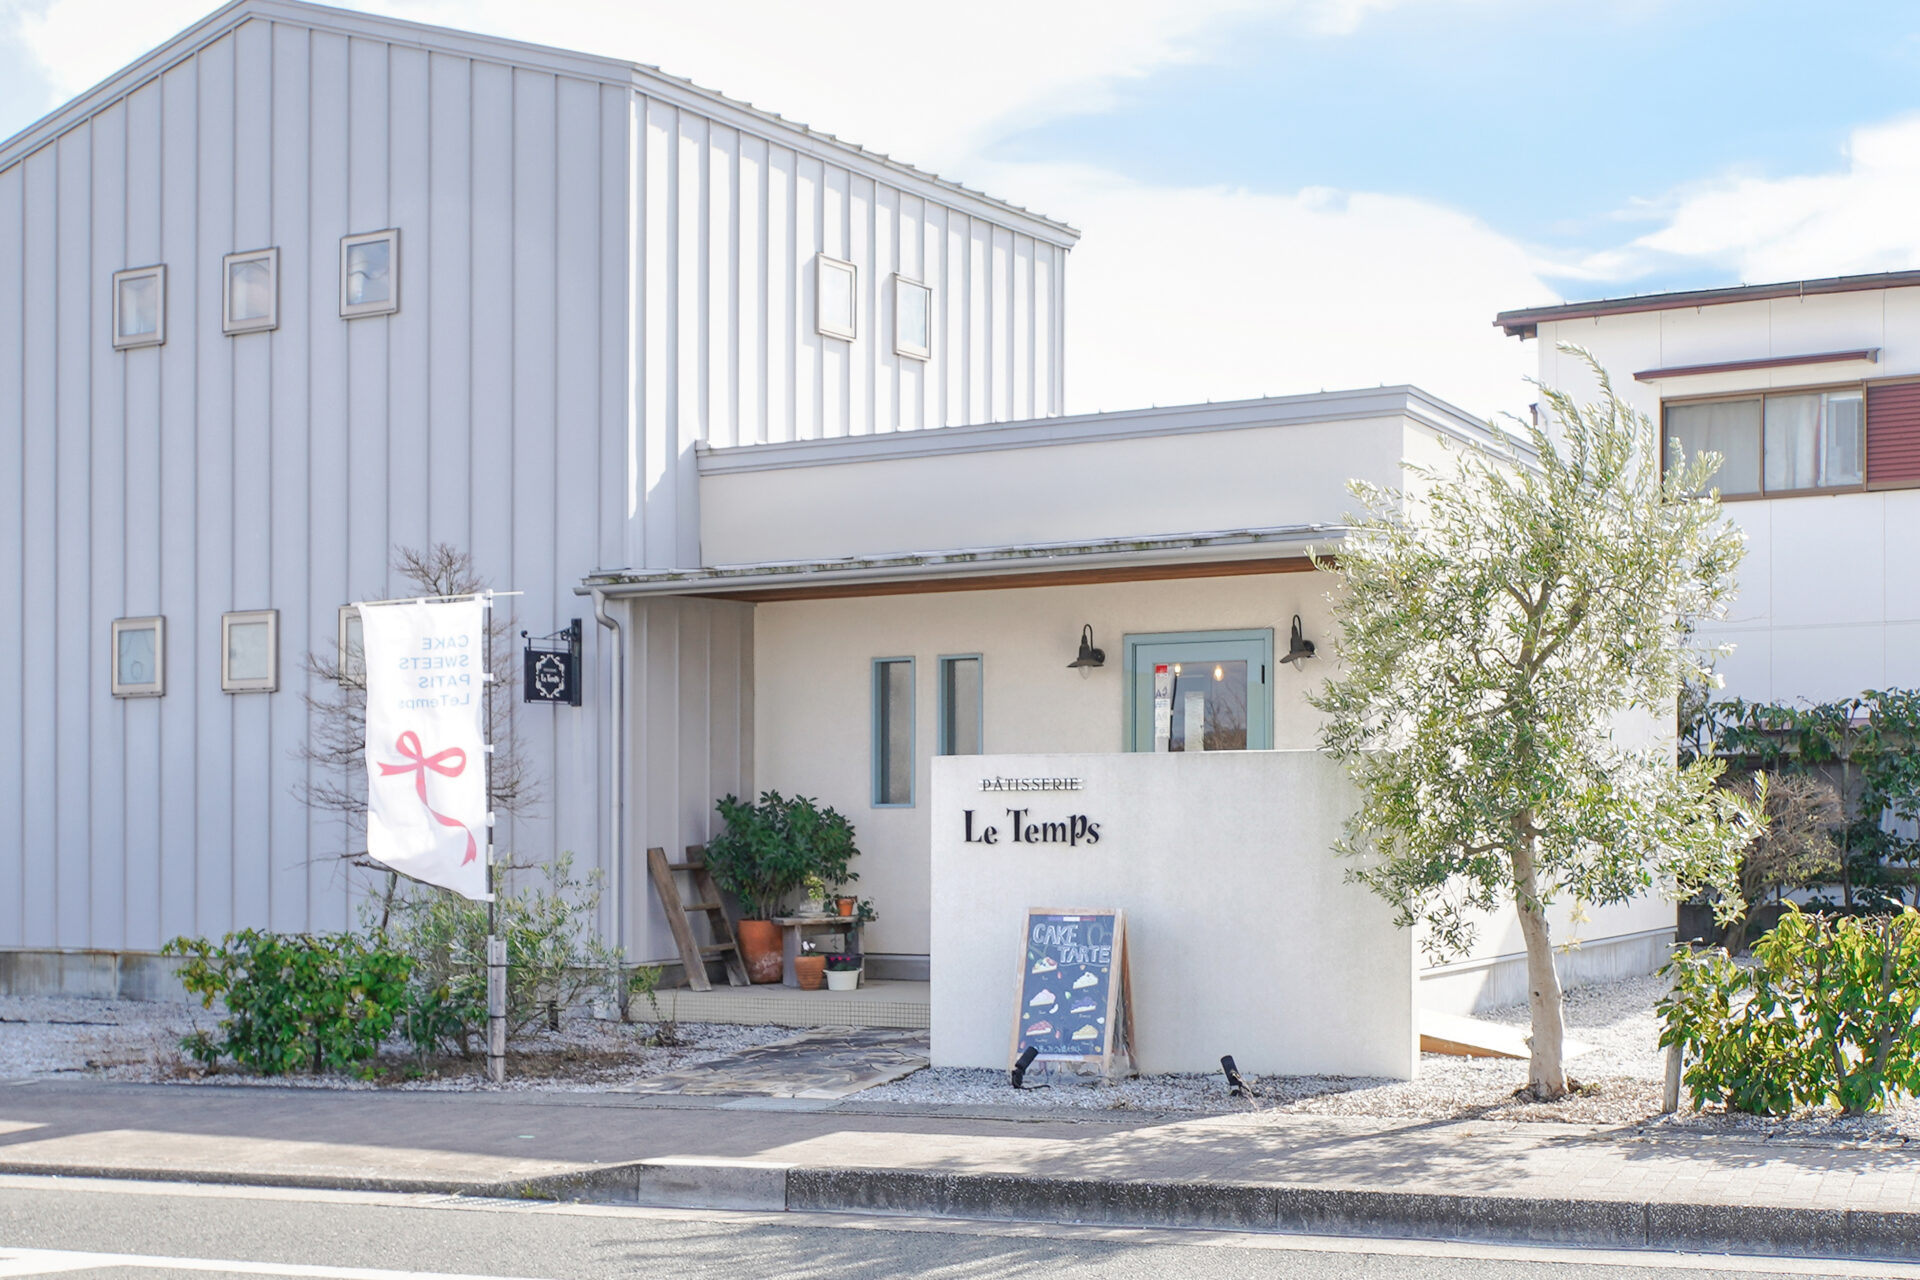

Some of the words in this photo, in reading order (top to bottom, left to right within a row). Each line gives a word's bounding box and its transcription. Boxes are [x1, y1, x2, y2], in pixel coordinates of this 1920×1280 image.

[982, 776, 1079, 792] PÂTISSERIE
[962, 809, 998, 844] Le
[1006, 808, 1100, 846] Temps
[1032, 923, 1078, 946] CAKE
[1058, 945, 1111, 963] TARTE
